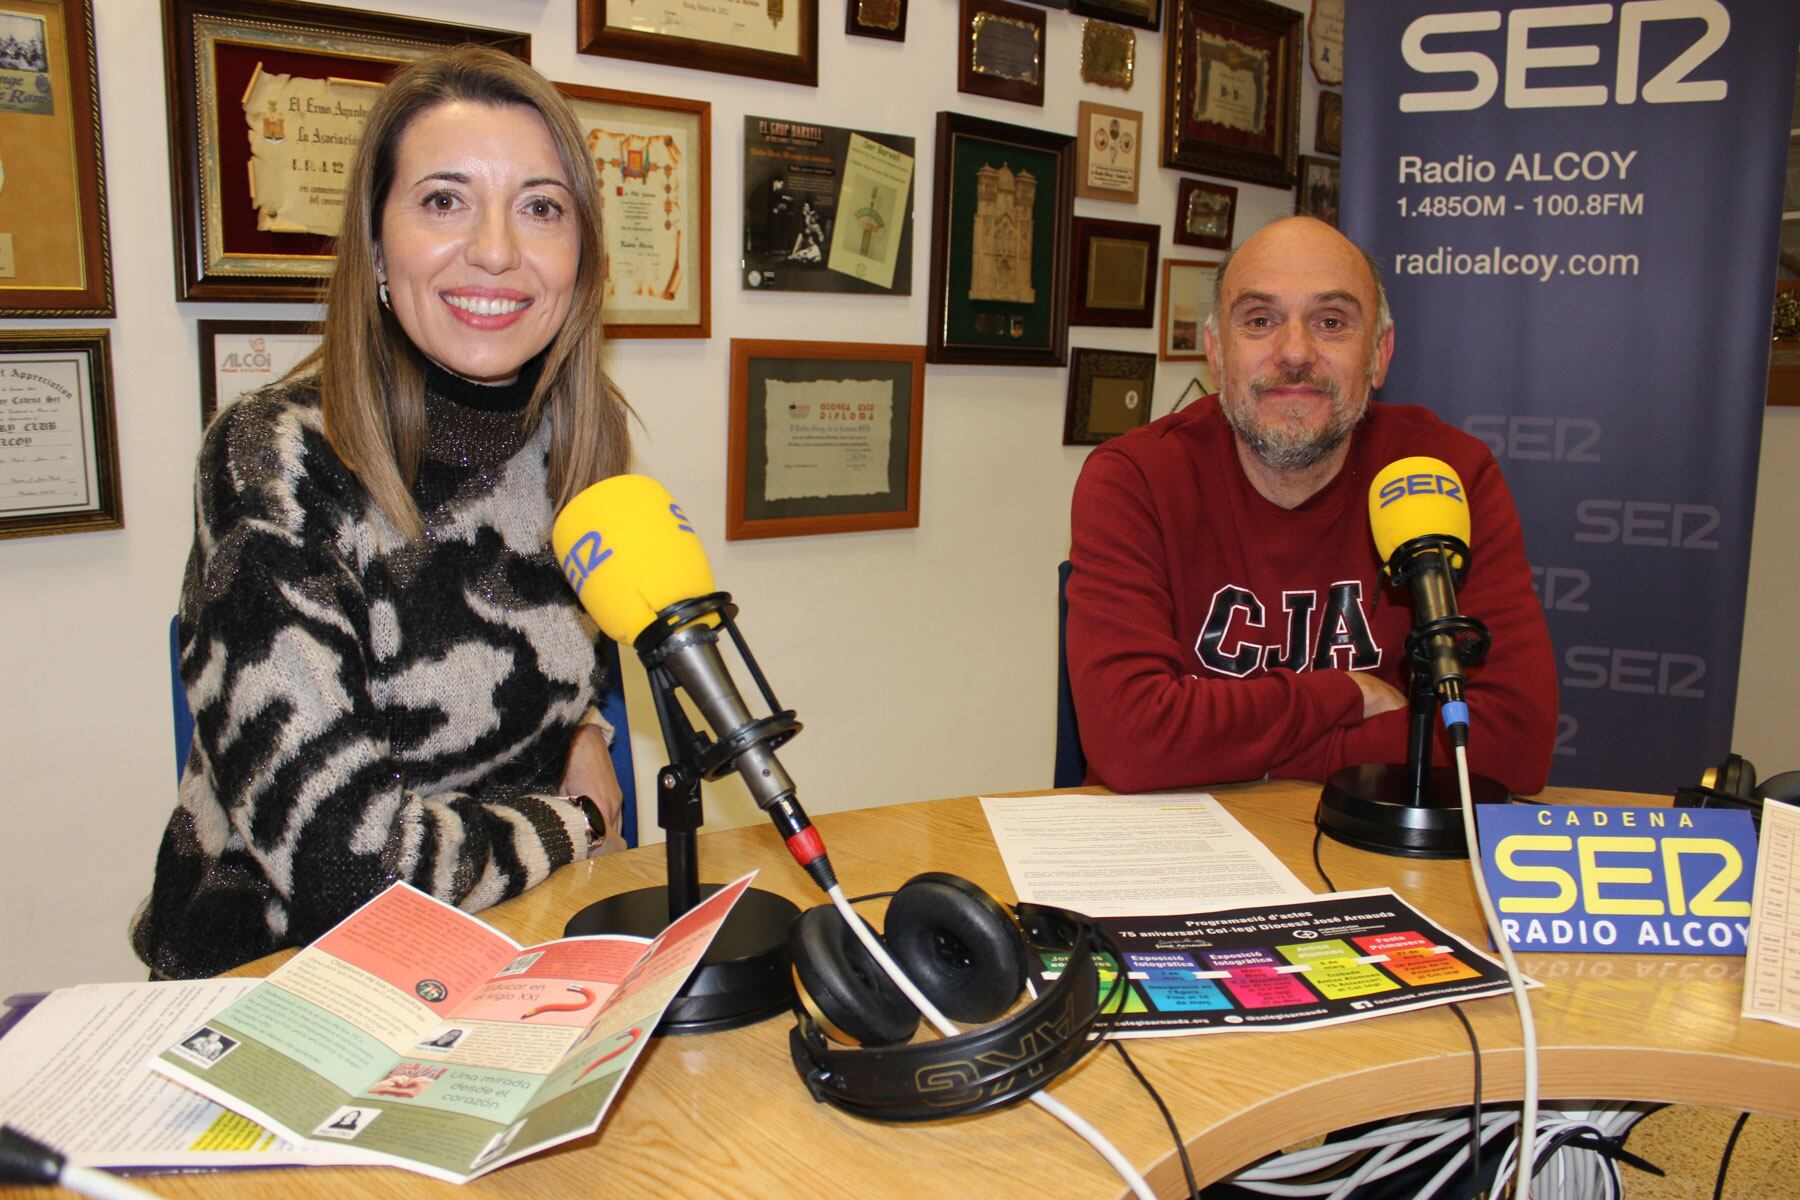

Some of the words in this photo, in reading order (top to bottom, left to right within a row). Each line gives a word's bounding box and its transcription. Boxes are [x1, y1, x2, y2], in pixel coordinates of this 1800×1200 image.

[1399, 0, 1732, 113] SER
[1398, 155, 1497, 184] Radio
[1505, 150, 1639, 183] ALCOY
[1532, 194, 1645, 217] 100.8FM
[1394, 246, 1640, 283] radioalcoy.com
[1379, 473, 1464, 509] SER
[1574, 500, 1722, 550] SER
[1194, 580, 1383, 678] CJA
[1563, 645, 1707, 699] SER
[1537, 810, 1694, 828] CADENA
[1495, 834, 1752, 918] SER
[1185, 914, 1267, 927] Programació
[1268, 911, 1314, 921] d'actes
[1313, 916, 1342, 926] José
[1343, 910, 1397, 922] Arnauda
[1501, 918, 1618, 945] RADIO
[1637, 920, 1751, 947] ALCOY
[1130, 954, 1184, 962] Exposició
[1209, 951, 1263, 961] Exposició
[450, 1071, 479, 1081] Una
[481, 1075, 531, 1090] mirada
[450, 1082, 494, 1095] desde
[495, 1088, 511, 1098] el
[442, 1093, 500, 1110] corazón
